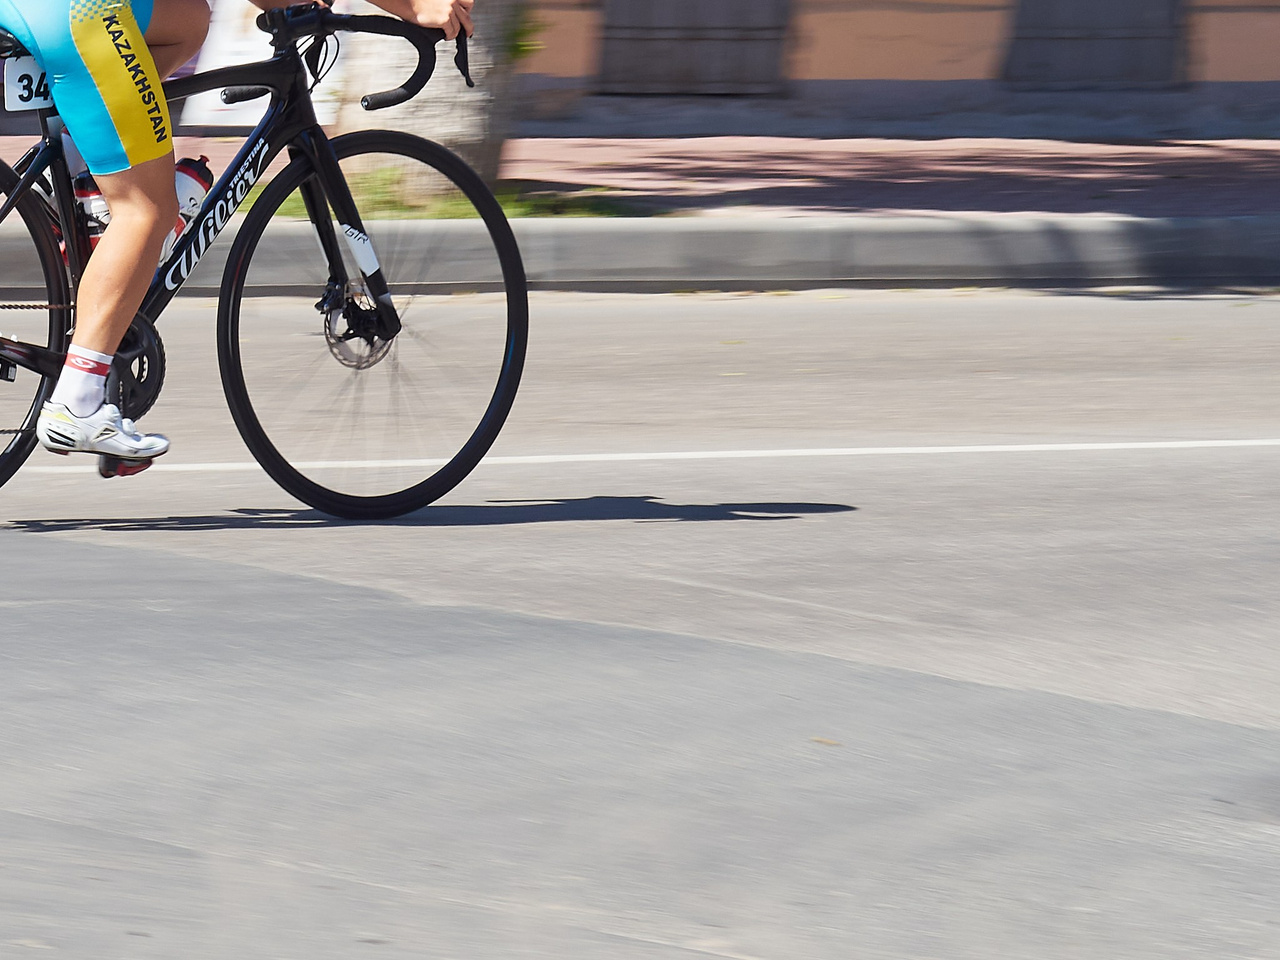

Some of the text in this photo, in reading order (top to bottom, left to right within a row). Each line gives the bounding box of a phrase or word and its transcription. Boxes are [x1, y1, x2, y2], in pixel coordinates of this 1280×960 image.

[17, 71, 50, 102] 34
[103, 13, 167, 143] KAZAKHSTAN
[229, 137, 266, 188] TRIESTINA
